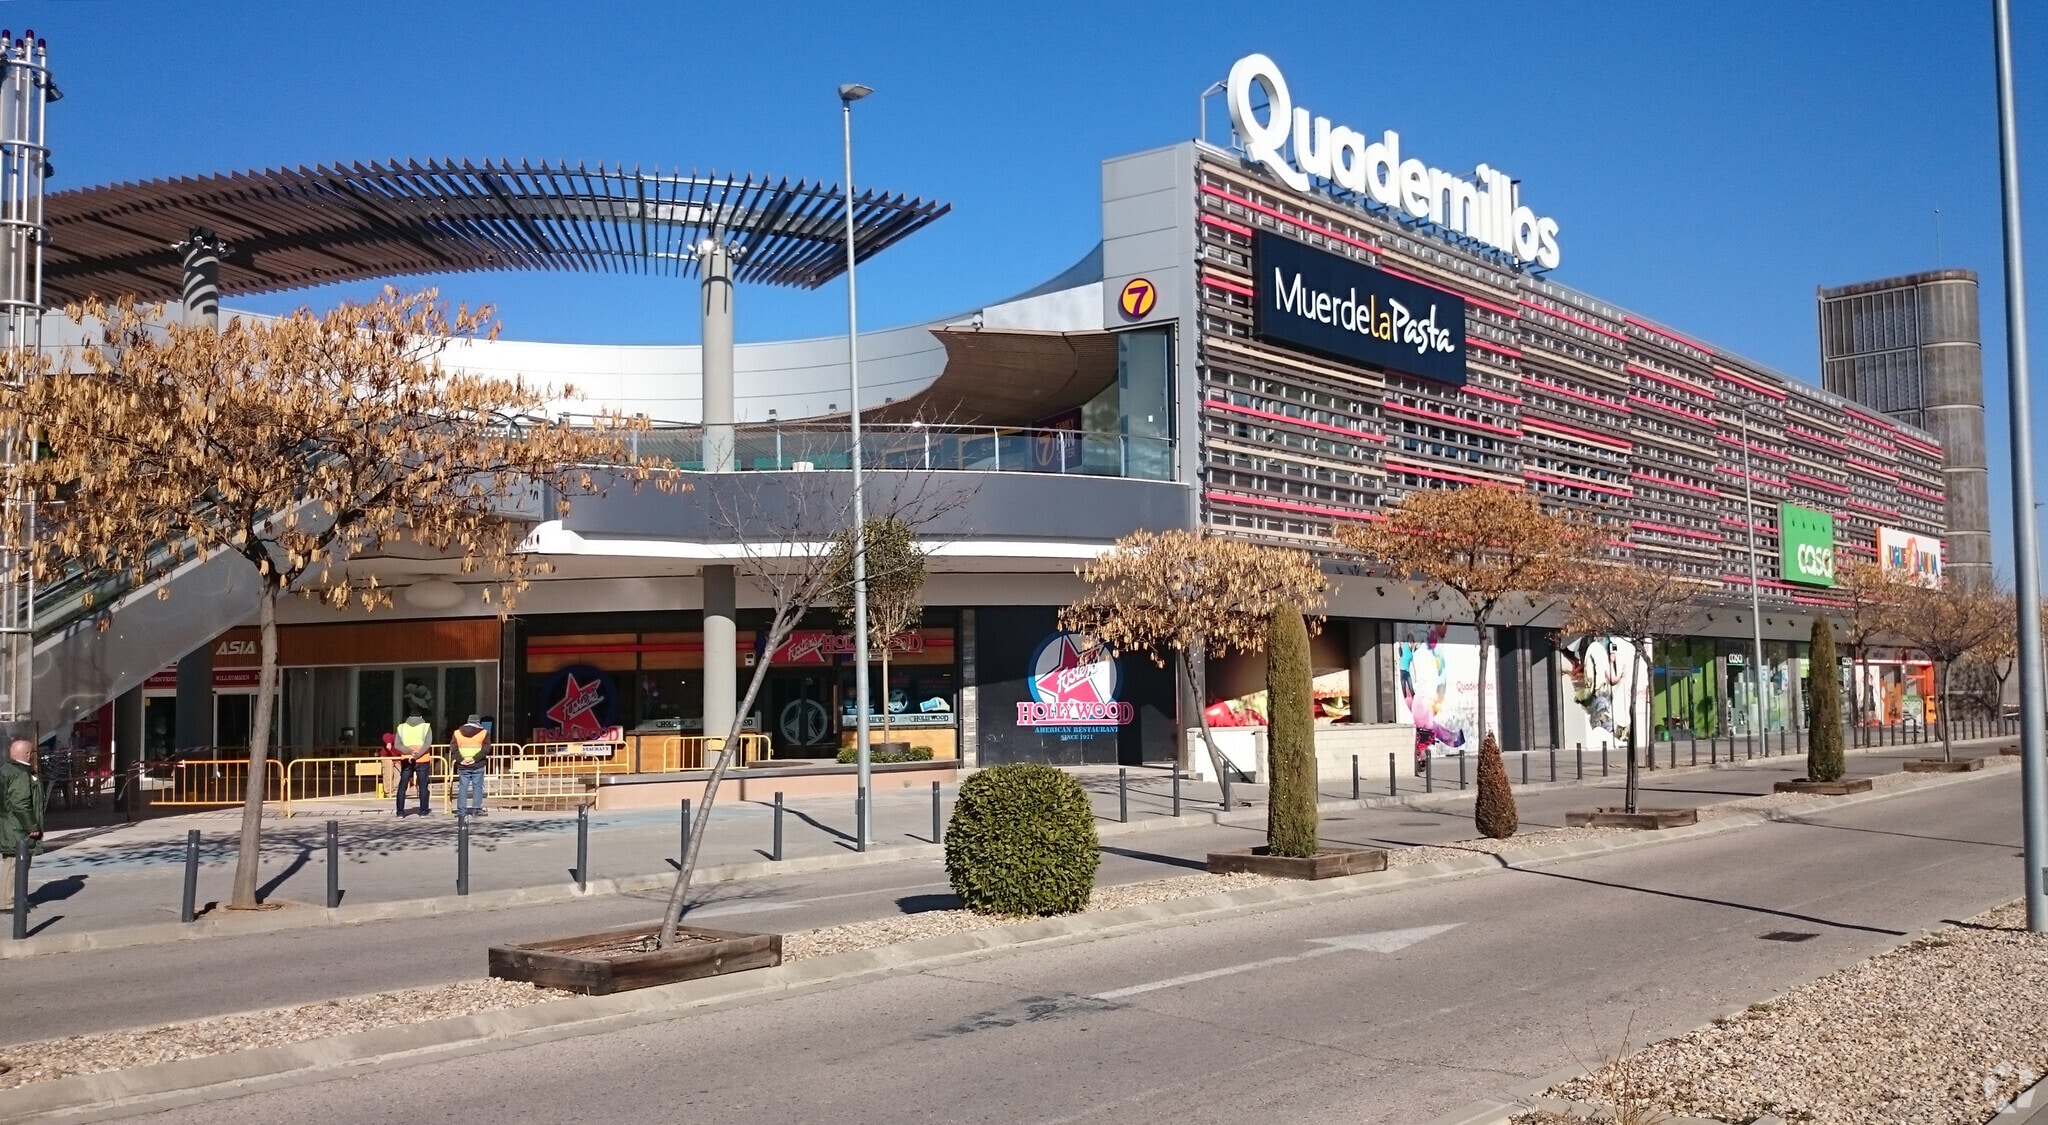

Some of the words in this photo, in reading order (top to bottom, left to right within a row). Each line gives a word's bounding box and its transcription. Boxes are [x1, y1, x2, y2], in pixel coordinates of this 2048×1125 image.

[1227, 53, 1560, 269] Quadernillos
[1127, 286, 1150, 316] 7
[1798, 543, 1833, 579] casa
[215, 640, 257, 656] ASIA
[821, 633, 923, 654] HOLOOD
[1016, 701, 1135, 725] HOLLYWOOD
[1034, 726, 1072, 734] AMERICAN
